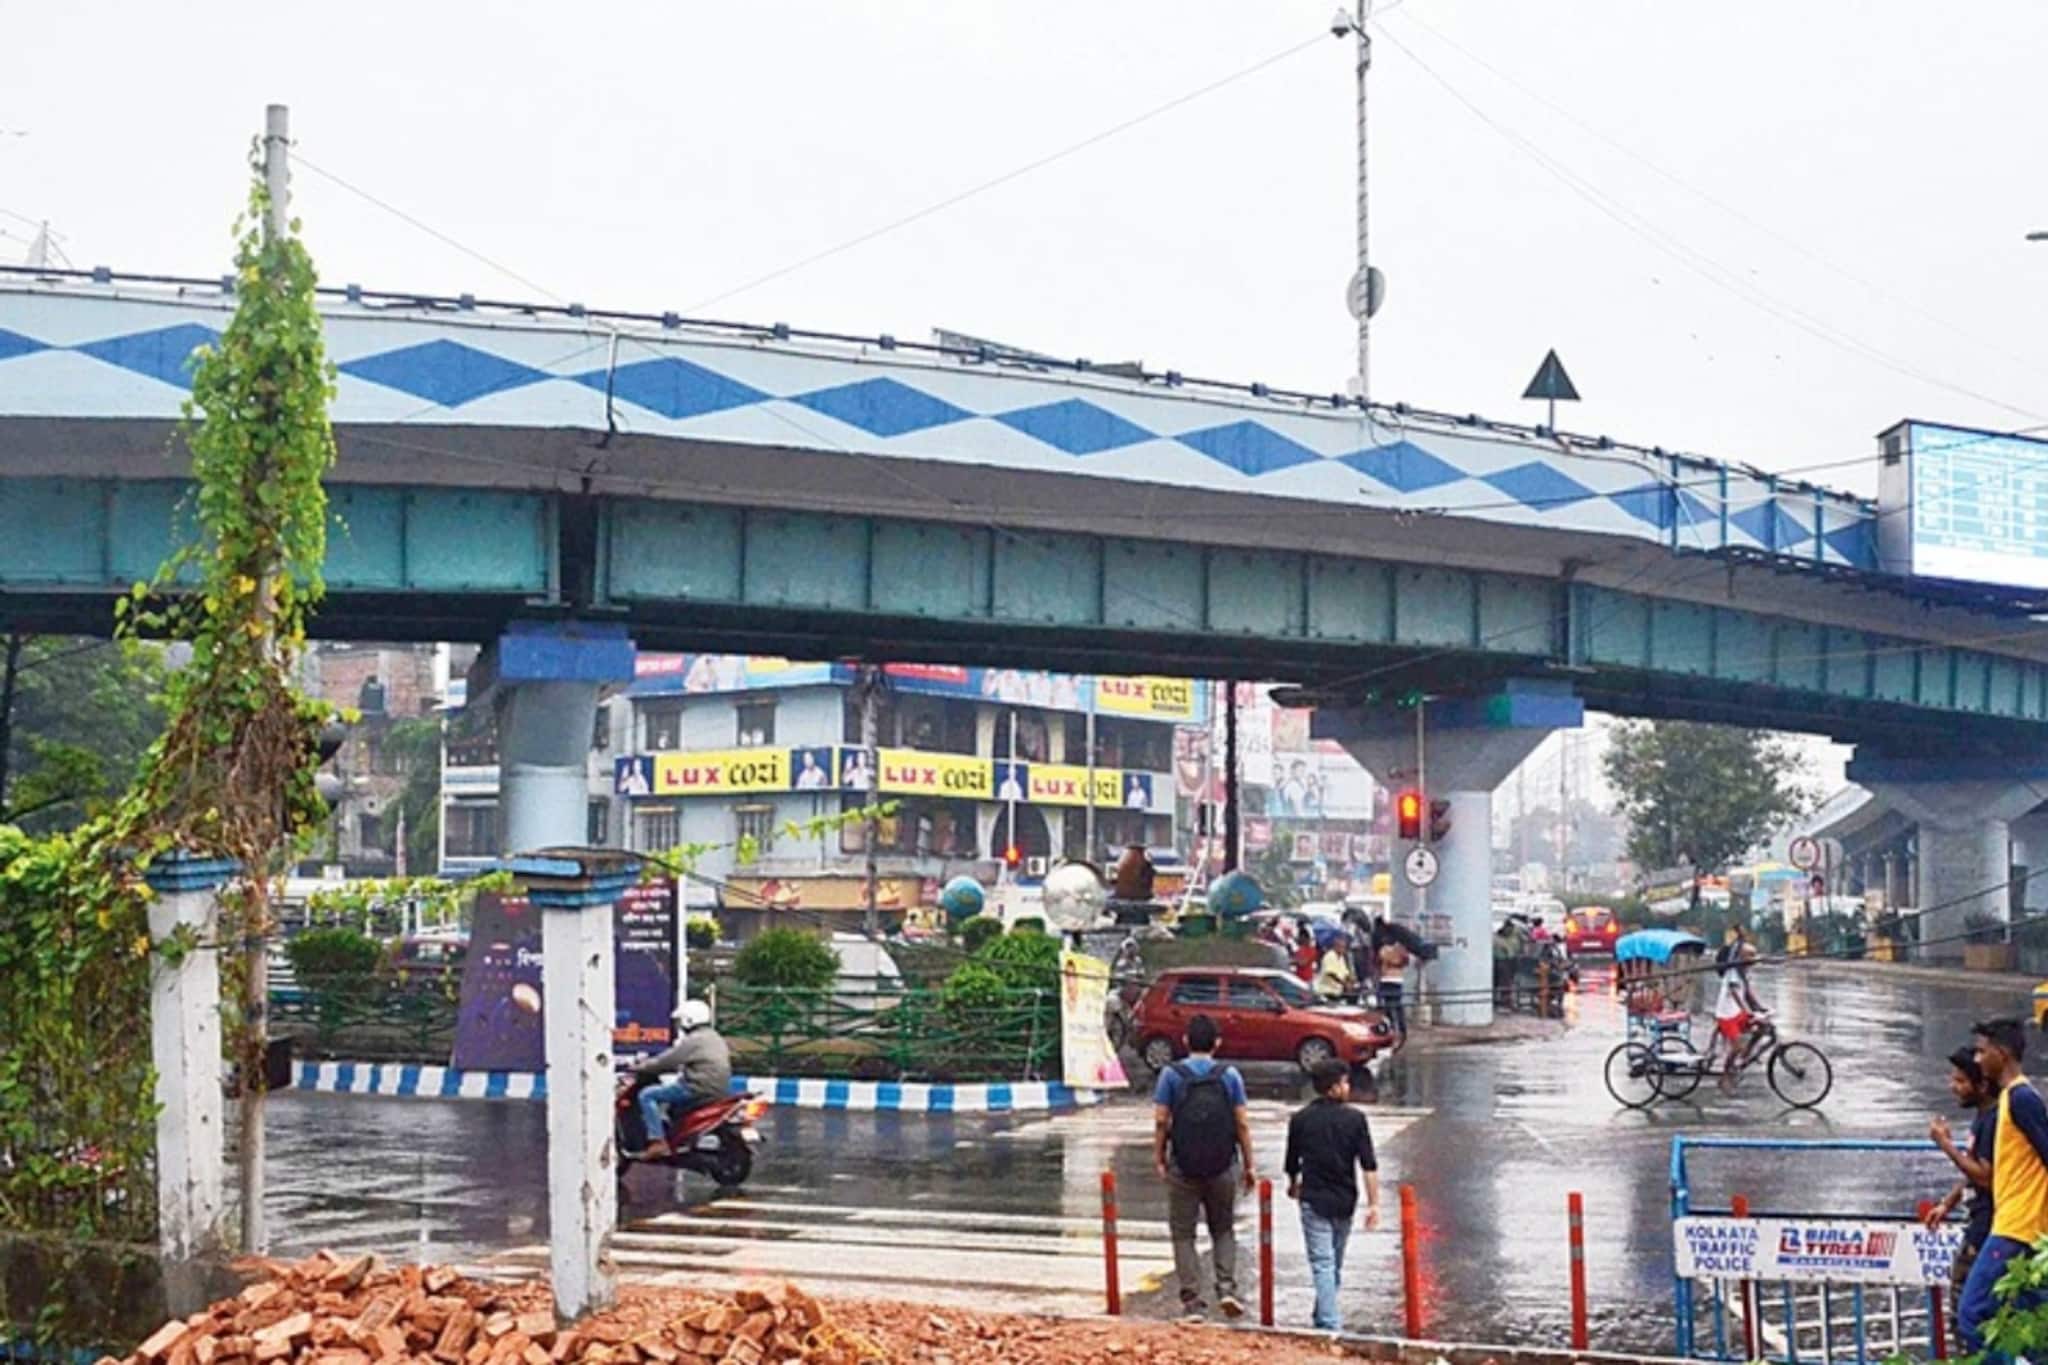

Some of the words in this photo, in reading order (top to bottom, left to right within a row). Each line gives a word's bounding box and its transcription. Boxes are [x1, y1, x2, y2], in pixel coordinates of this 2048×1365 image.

[1102, 680, 1145, 699] LUX
[666, 767, 720, 785] LUX
[729, 755, 779, 786] cozi
[885, 765, 936, 785] LUX
[943, 764, 986, 791] cozi
[1033, 778, 1075, 796] LUX
[1685, 1225, 1759, 1240] KOLKATA
[1806, 1228, 1864, 1242] BIRLA
[1913, 1231, 1960, 1248] KOLK
[1689, 1240, 1756, 1256] TRAFFIC
[1806, 1242, 1863, 1256] TYRES
[1917, 1247, 1957, 1261] TRA
[1694, 1256, 1752, 1272] POLICE
[1921, 1262, 1953, 1280] POL
